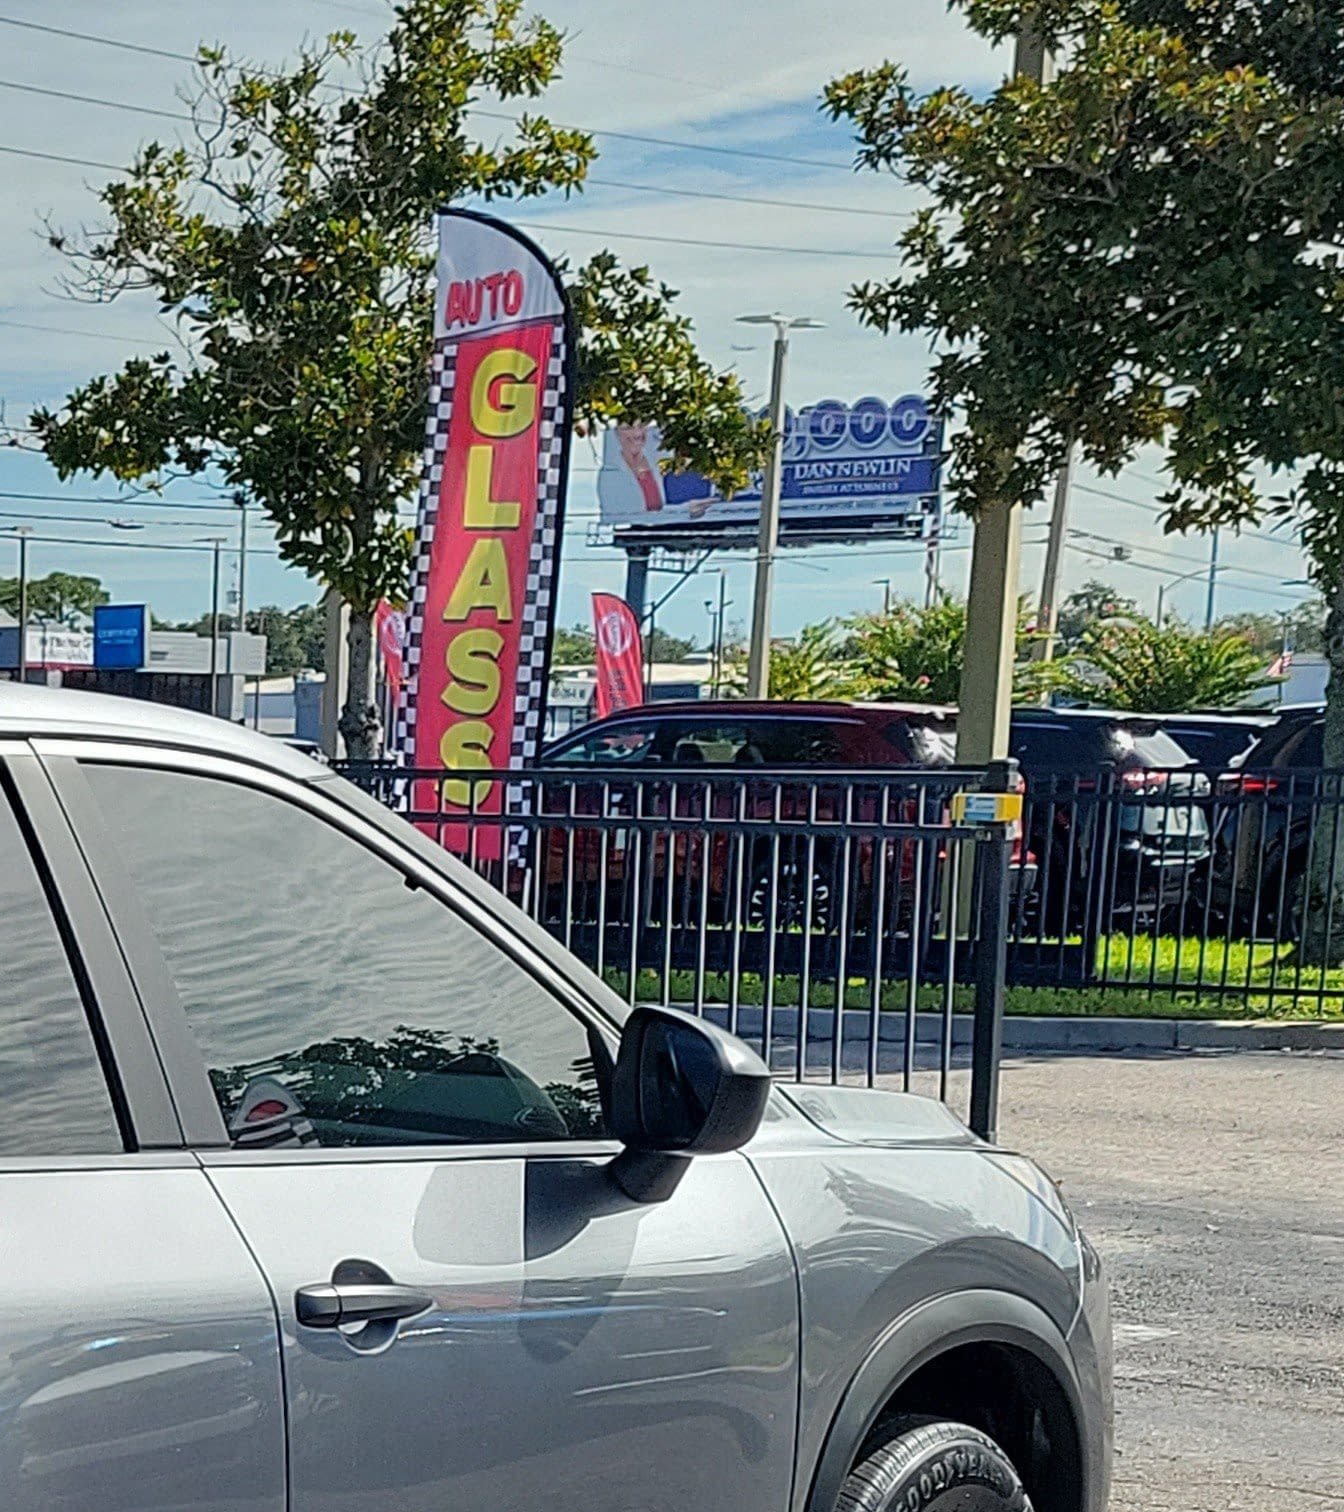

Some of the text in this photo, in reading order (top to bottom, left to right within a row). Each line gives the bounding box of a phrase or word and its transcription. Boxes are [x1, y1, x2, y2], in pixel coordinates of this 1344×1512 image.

[444, 269, 523, 330] AUTO
[794, 458, 912, 480] DAN NEWLIN
[436, 347, 538, 808] GLASS
